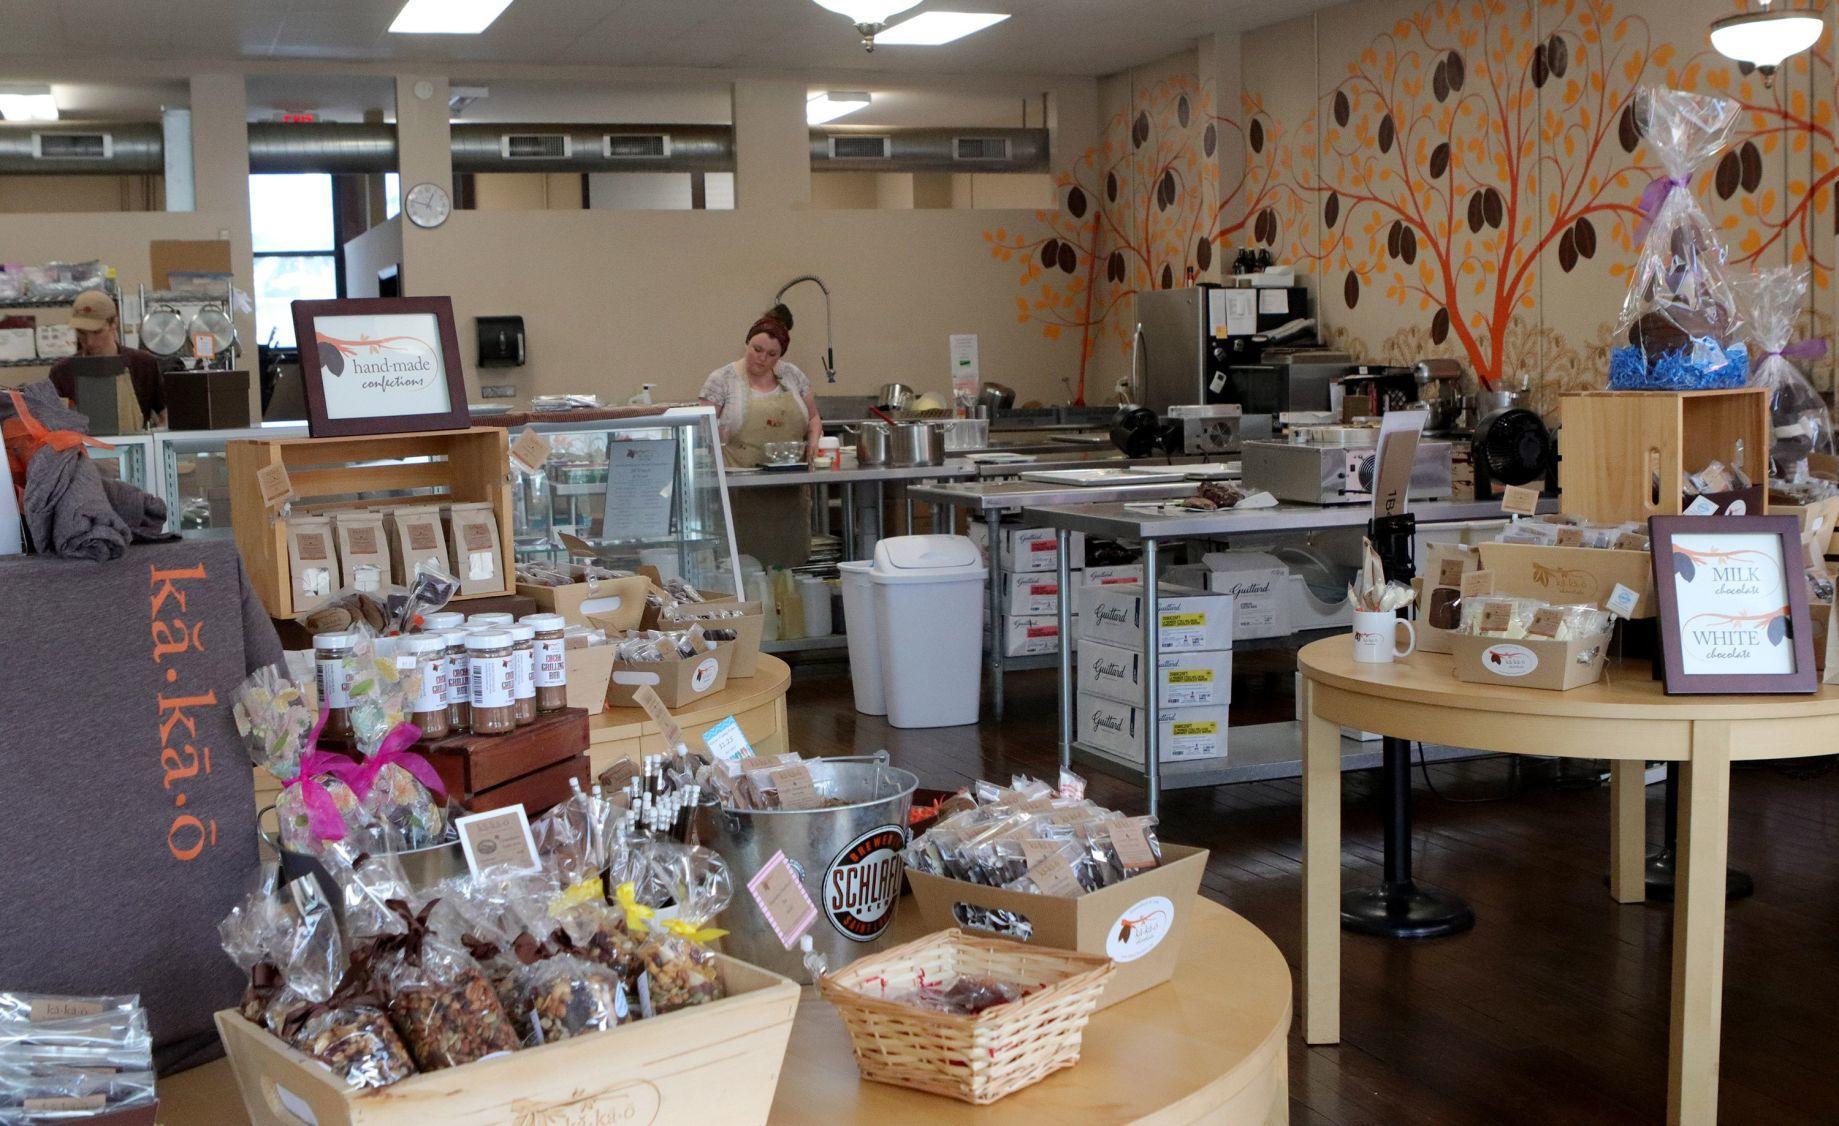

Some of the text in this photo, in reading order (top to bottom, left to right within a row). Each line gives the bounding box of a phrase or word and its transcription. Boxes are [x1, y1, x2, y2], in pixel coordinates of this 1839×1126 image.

[353, 356, 431, 374] hand-made
[362, 376, 424, 392] confections
[1712, 567, 1760, 581] MILK
[1229, 582, 1270, 600] Guittard
[1715, 584, 1760, 594] chocolate
[1094, 604, 1128, 626] Guittard
[1158, 603, 1181, 612] uittard
[1692, 631, 1760, 646] WHITE
[1706, 648, 1751, 658] chocolate
[1093, 658, 1126, 680] Guittard
[1159, 659, 1180, 668] uittard
[1092, 710, 1124, 732] Guittard
[832, 852, 902, 911] SCHLAFL
